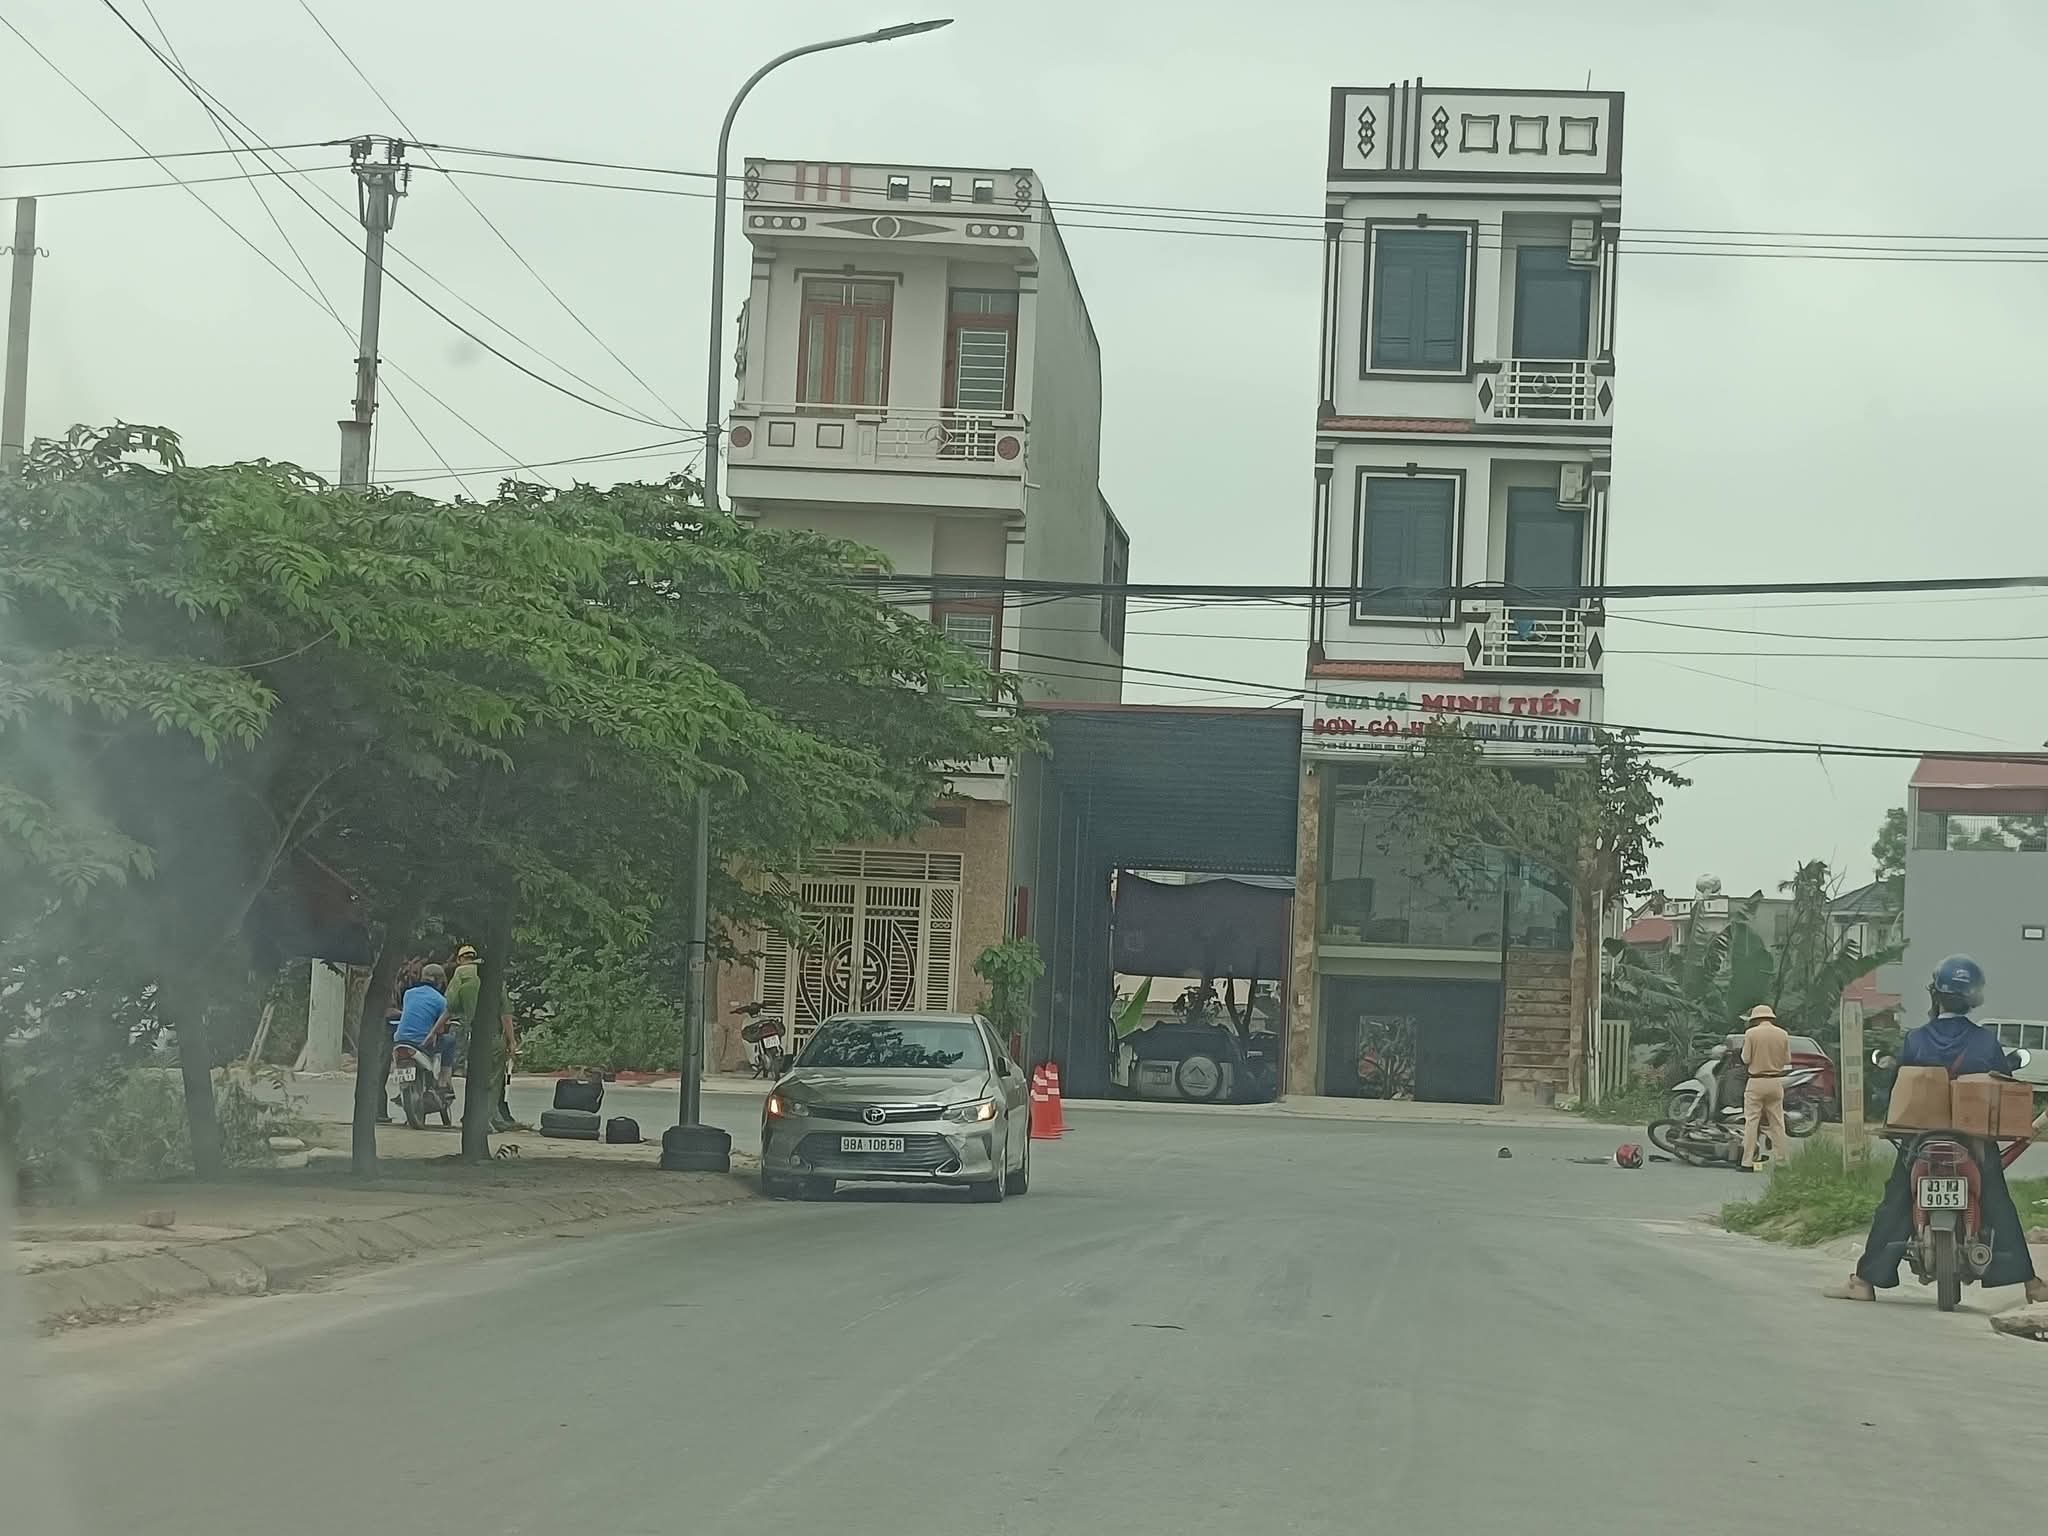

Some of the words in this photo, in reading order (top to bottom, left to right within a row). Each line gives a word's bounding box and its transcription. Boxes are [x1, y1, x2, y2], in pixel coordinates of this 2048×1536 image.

[1422, 694, 1502, 714] MINH
[1508, 689, 1582, 716] TIẾN
[1927, 1193, 1959, 1206] 9055
